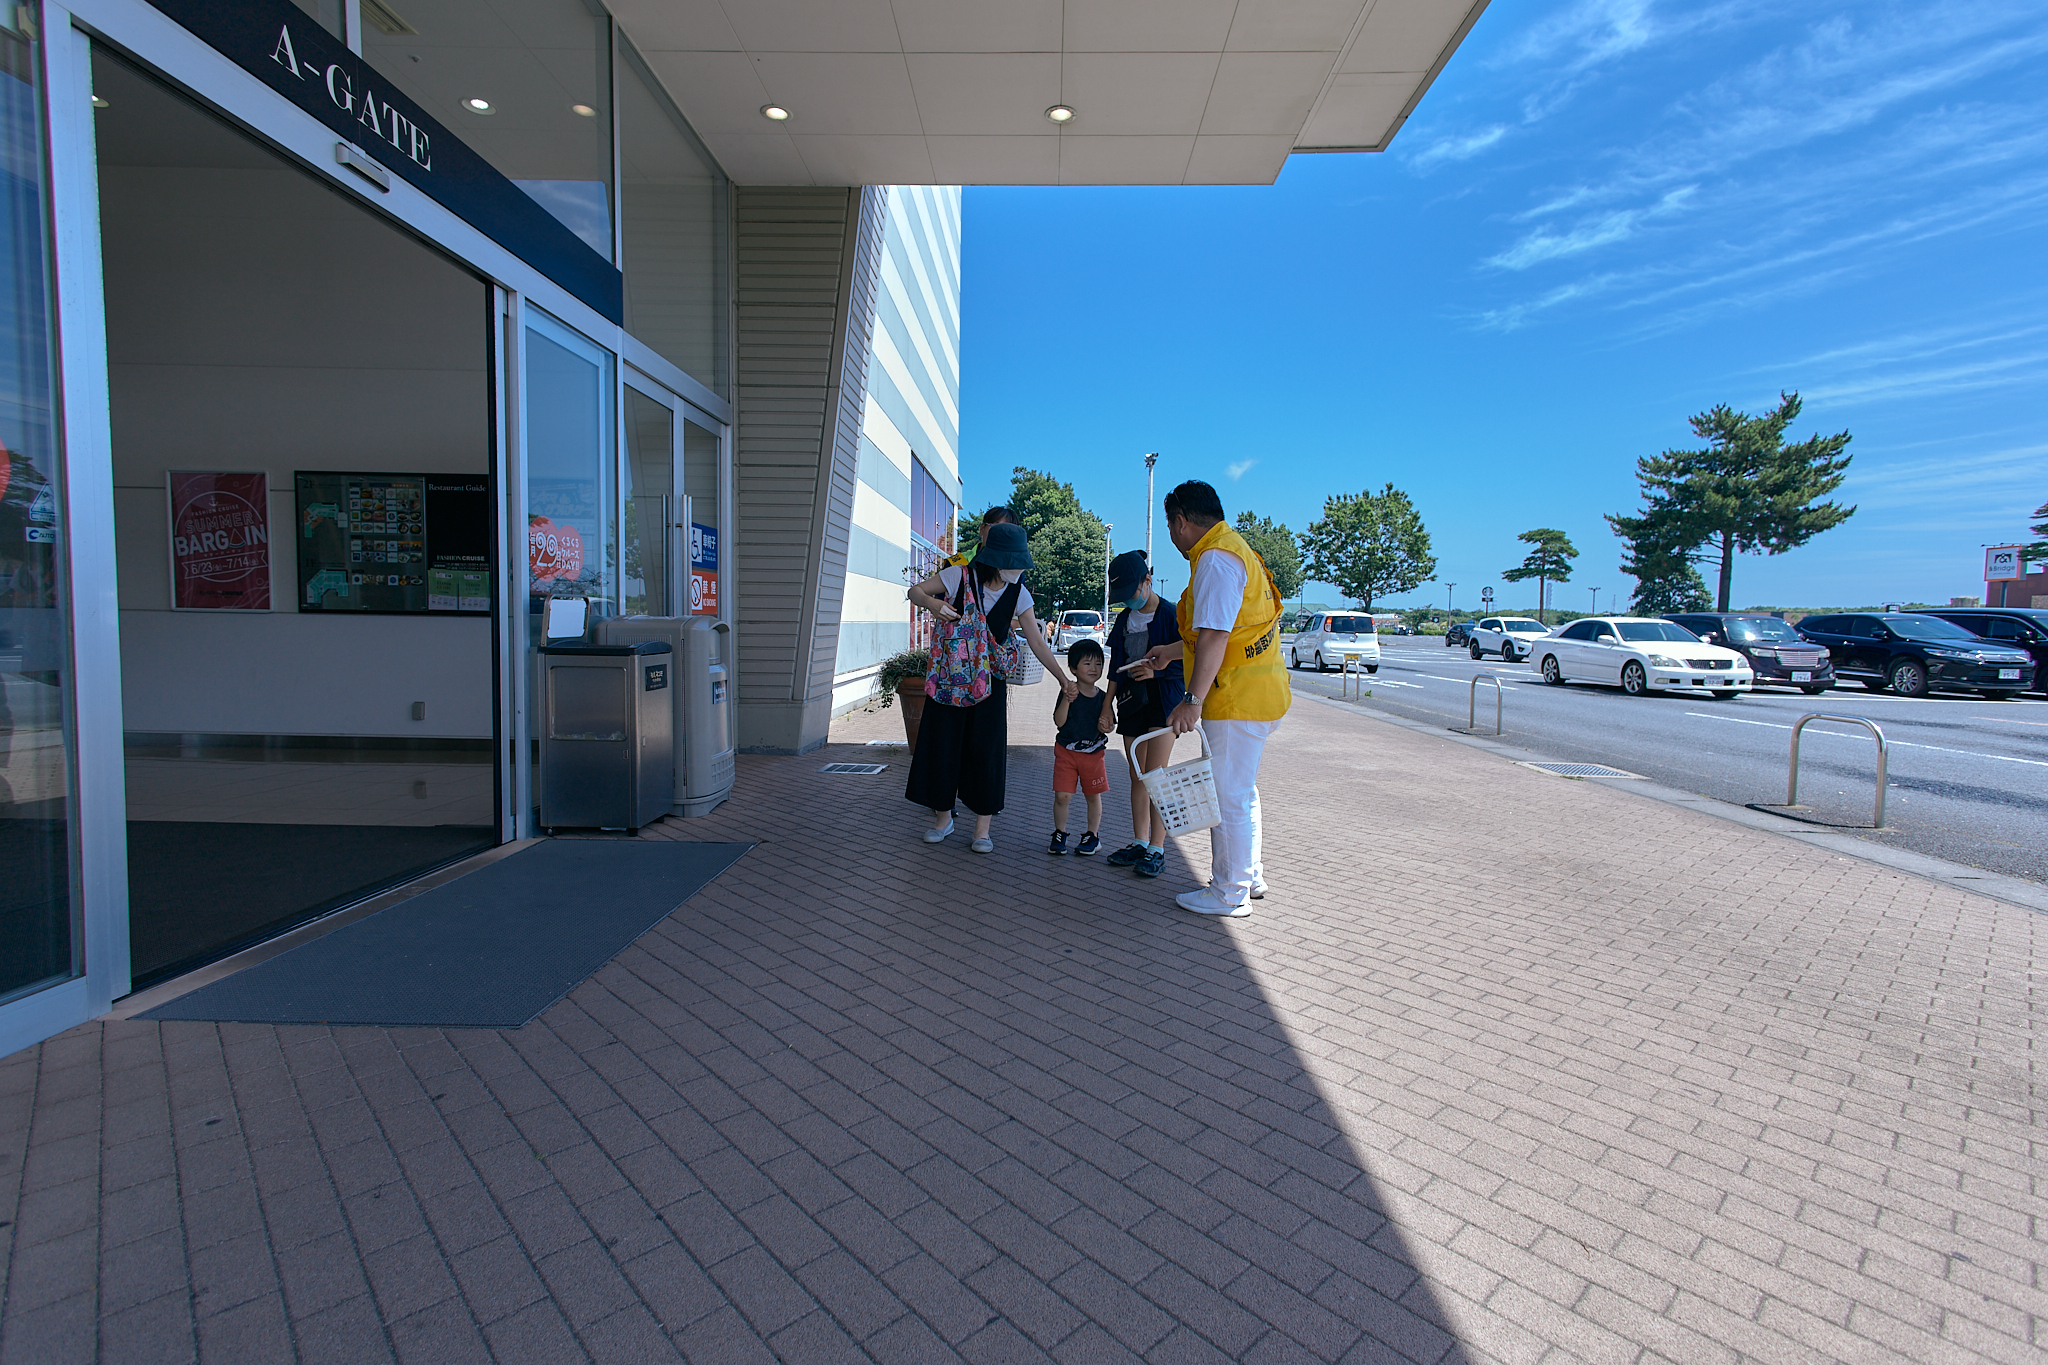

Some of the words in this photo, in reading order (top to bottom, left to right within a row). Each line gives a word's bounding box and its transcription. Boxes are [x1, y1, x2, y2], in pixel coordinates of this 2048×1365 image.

[269, 24, 432, 172] A-GATE
[428, 484, 464, 492] Restaurant
[465, 484, 487, 492] Guide
[185, 511, 254, 534] SUMMER
[561, 536, 580, 548] くるくる
[561, 548, 580, 559] クルーズ
[1092, 776, 1105, 786] GAP
